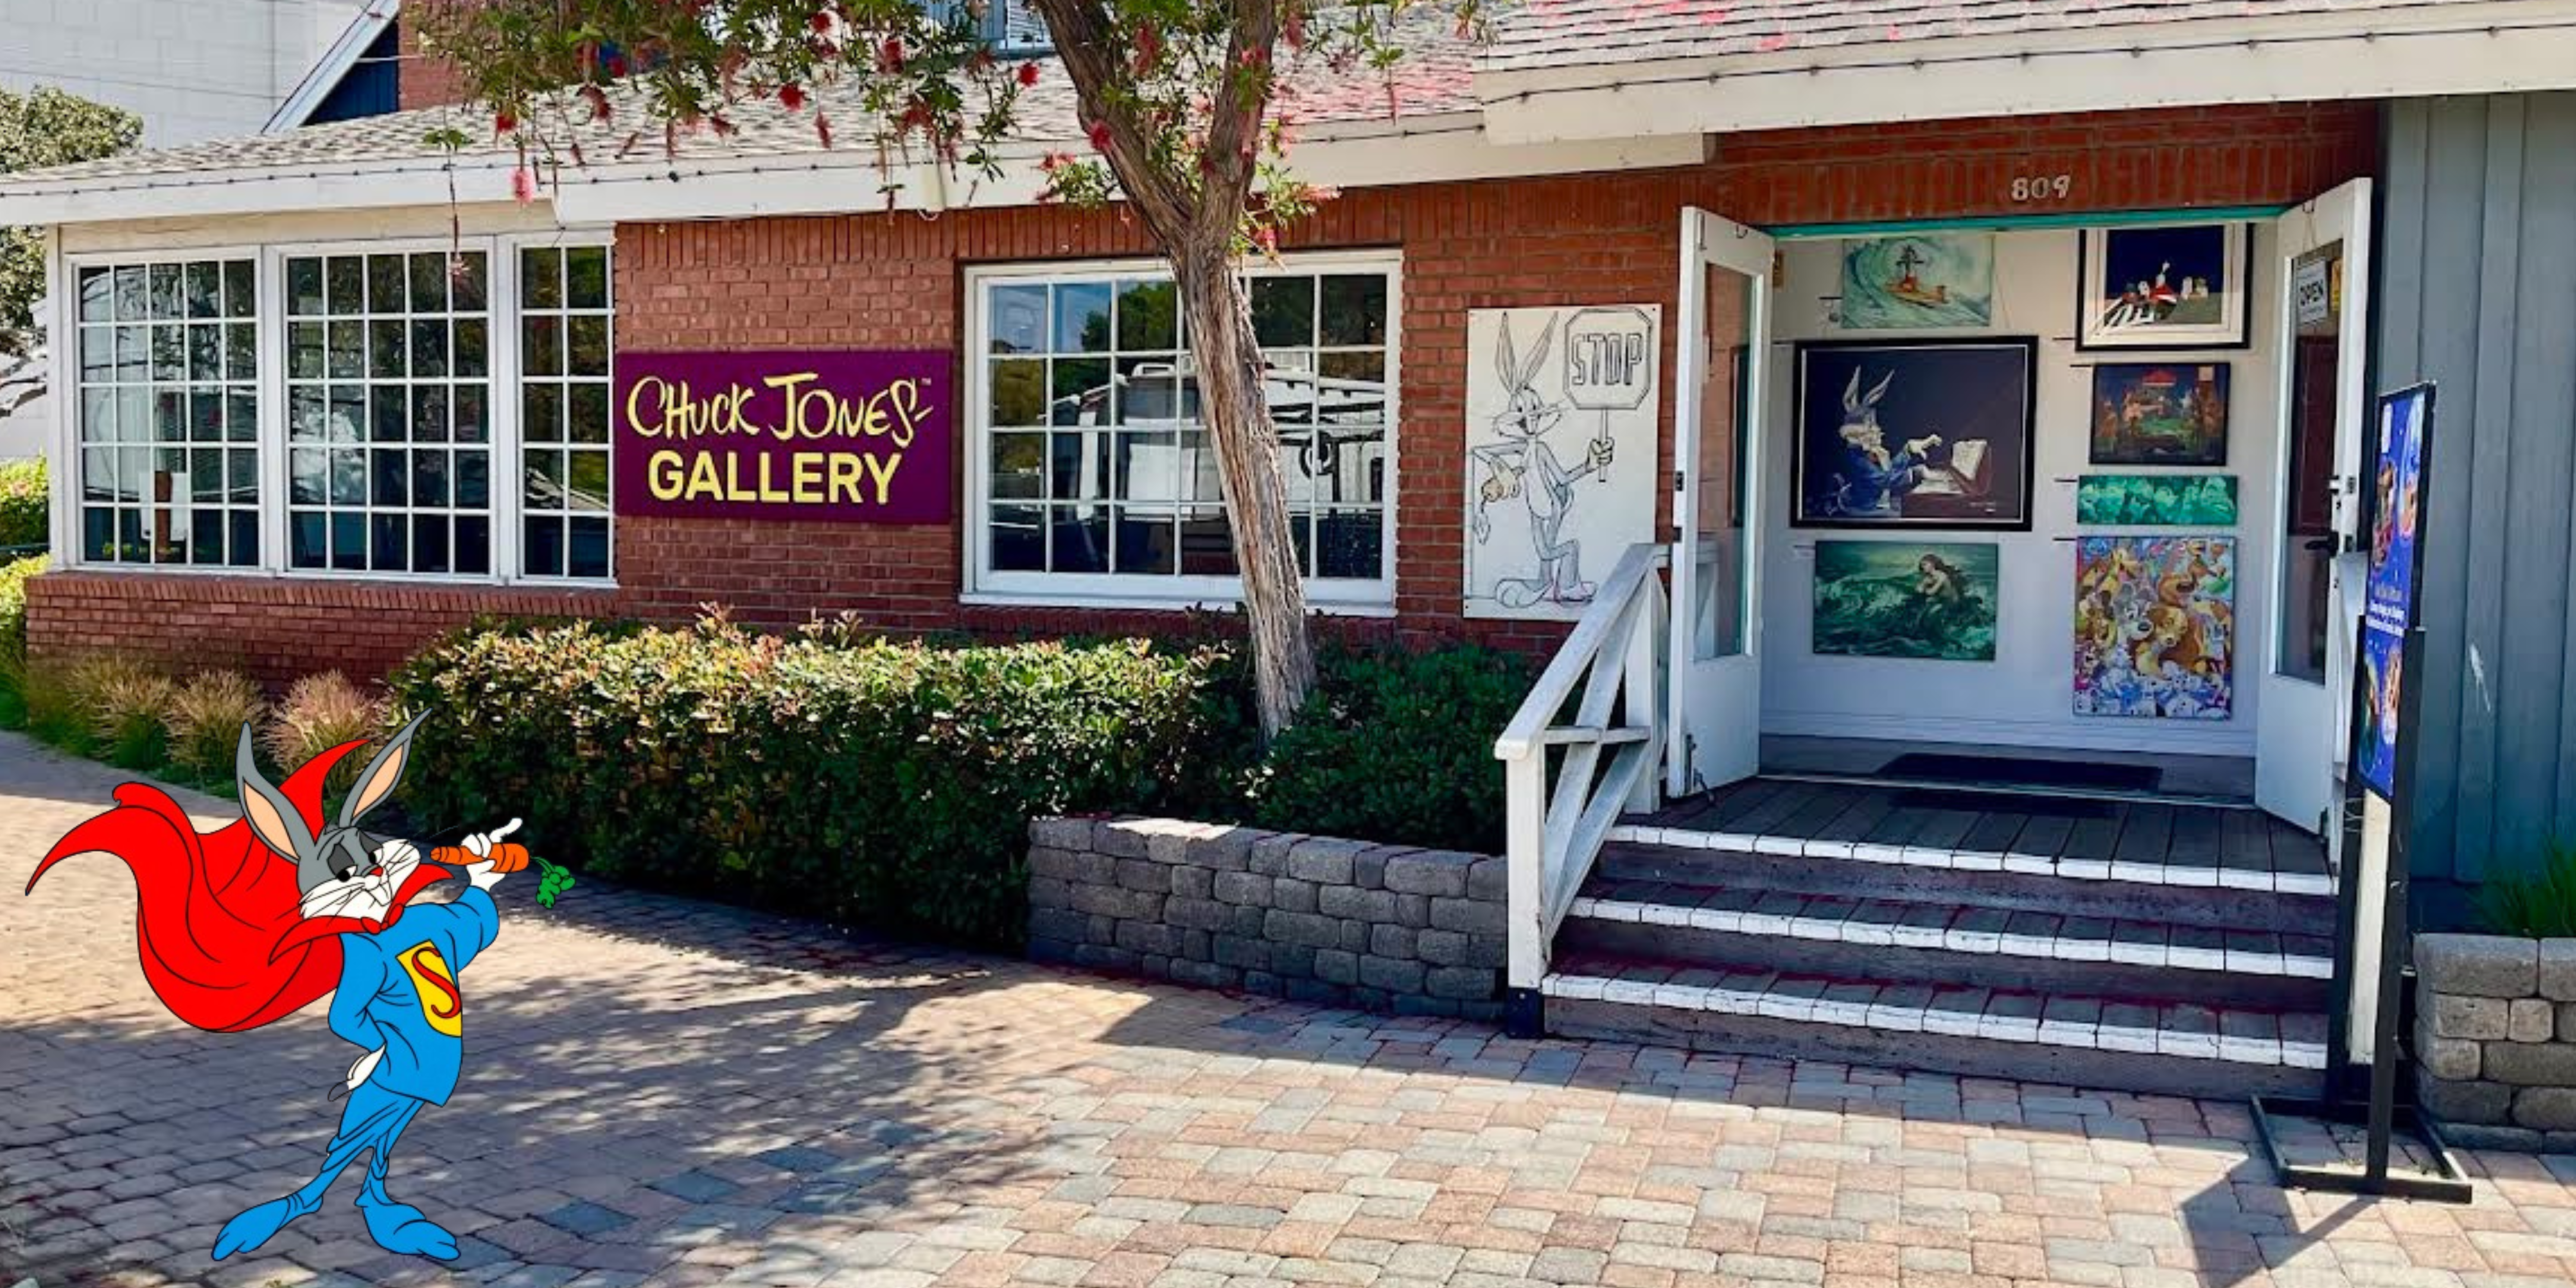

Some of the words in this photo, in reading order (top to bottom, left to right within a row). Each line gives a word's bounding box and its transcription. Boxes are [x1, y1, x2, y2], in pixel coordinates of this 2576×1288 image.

[2011, 175, 2071, 201] 809
[1571, 332, 1642, 385] STOP
[627, 376, 760, 440] CHUCK
[648, 450, 902, 505] GALLERY
